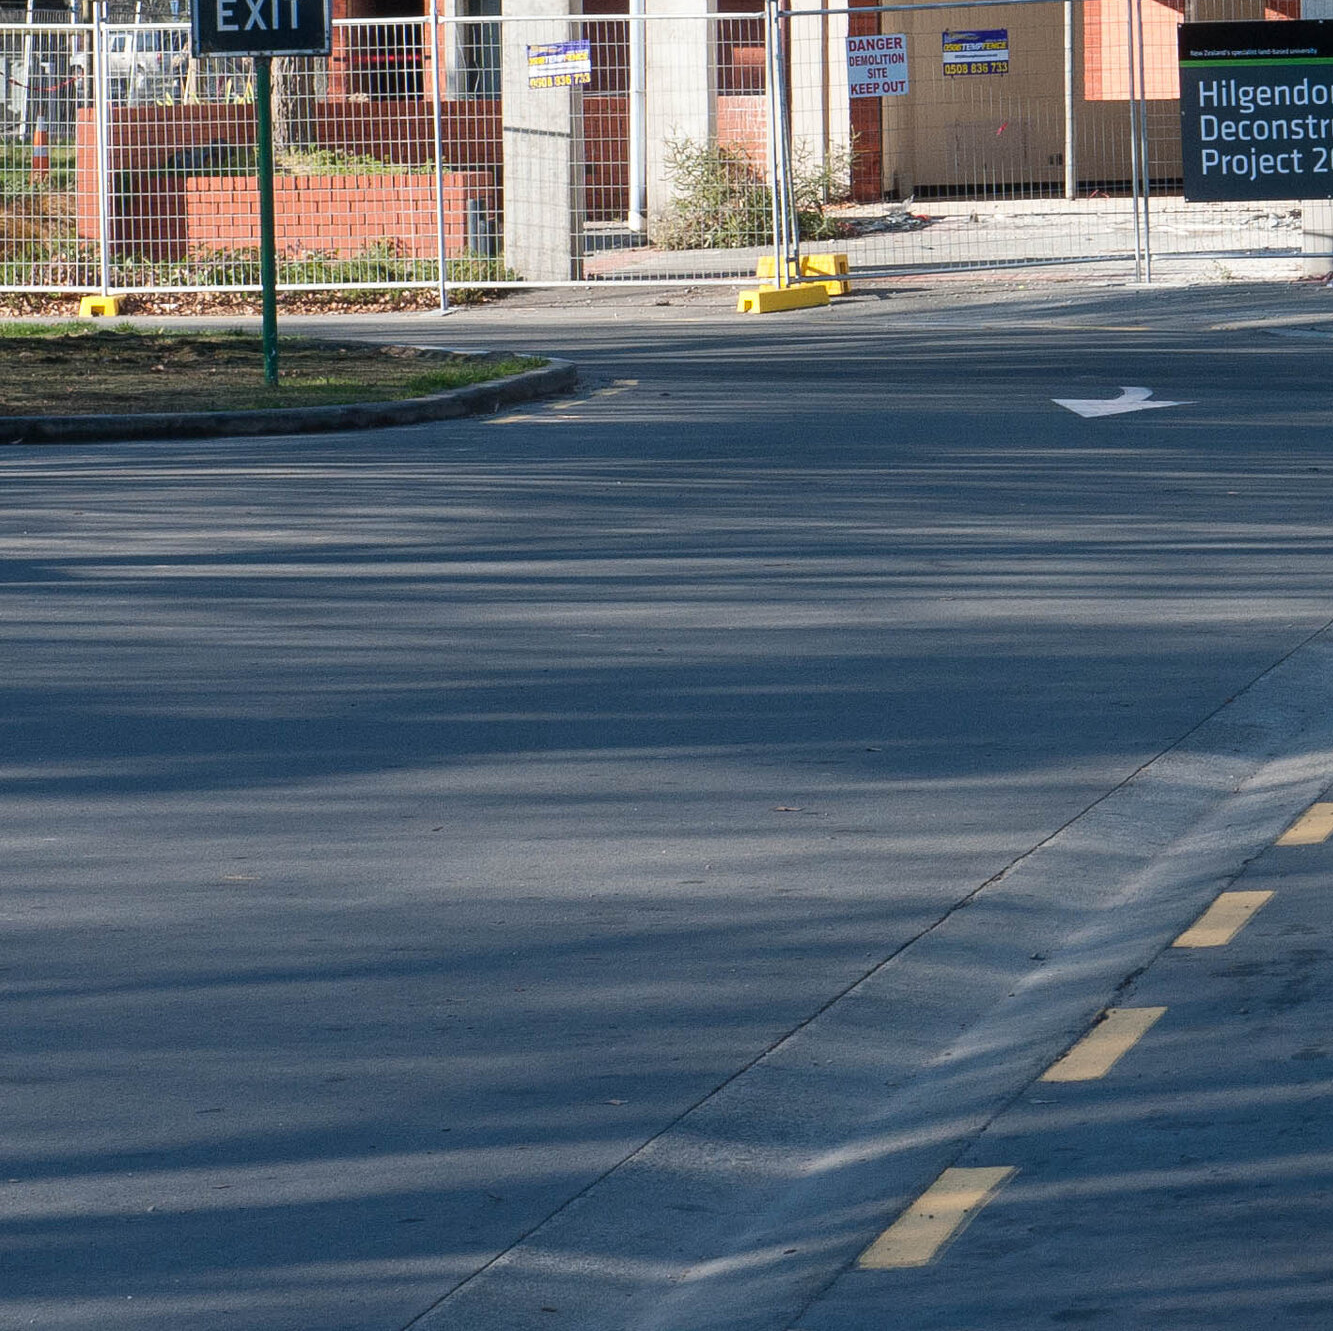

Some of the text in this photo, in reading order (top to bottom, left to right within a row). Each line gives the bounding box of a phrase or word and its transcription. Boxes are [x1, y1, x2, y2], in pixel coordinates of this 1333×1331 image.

[849, 37, 903, 52] DANGER
[849, 53, 905, 67] DEMOLITION
[867, 67, 888, 79] SITE
[945, 61, 1008, 74] 0508 836 733
[851, 80, 905, 95] KEEP OUT
[1202, 147, 1303, 181] Project
